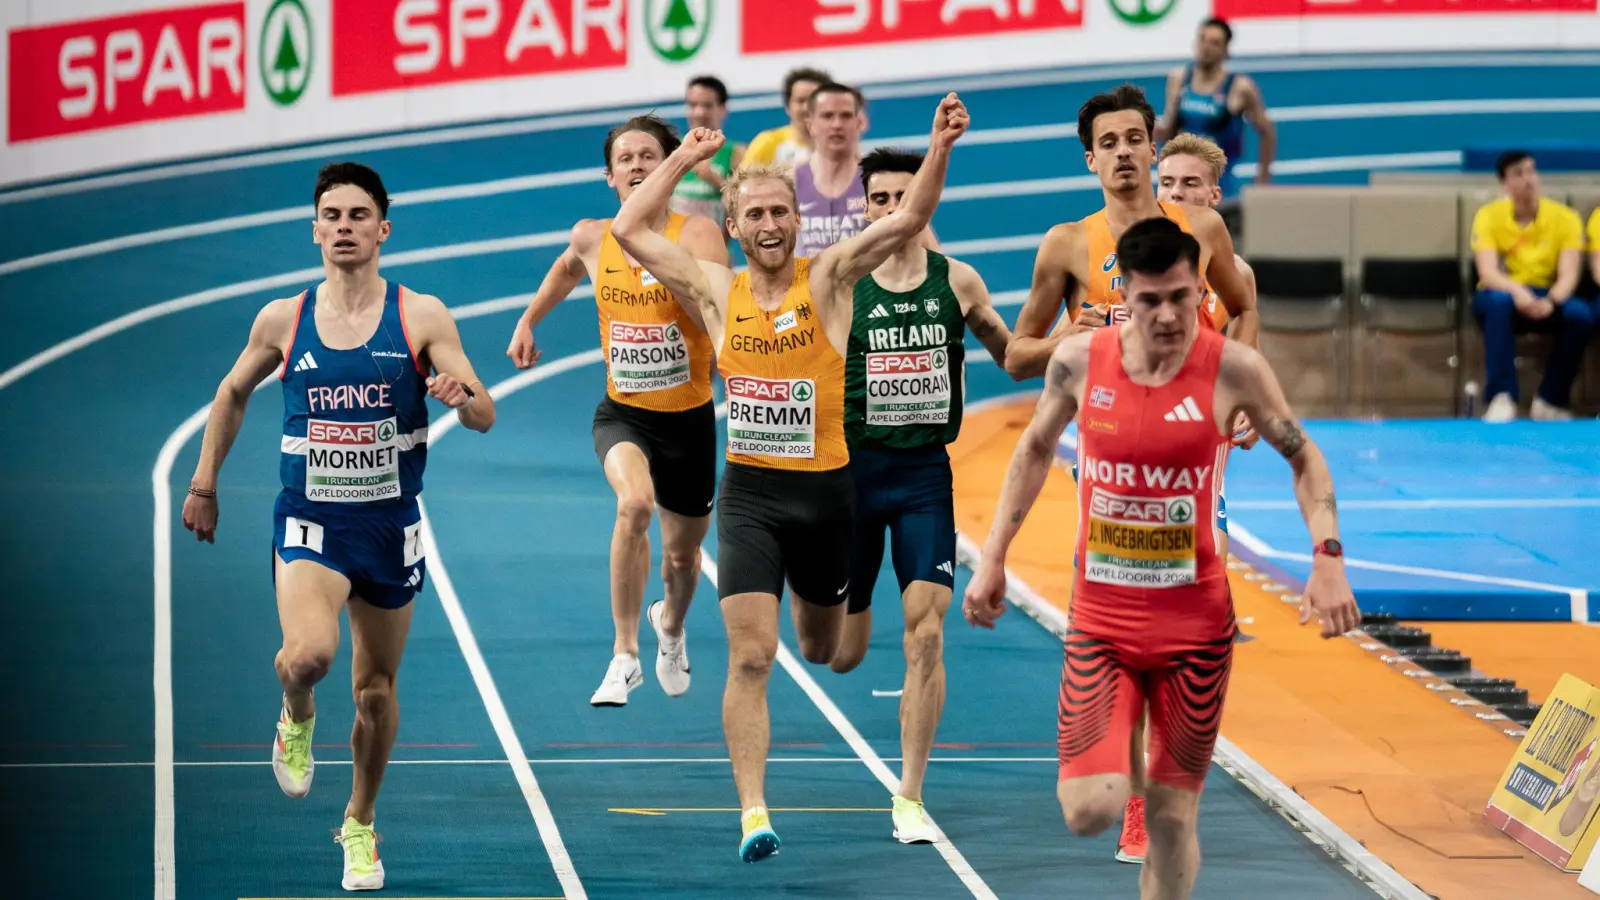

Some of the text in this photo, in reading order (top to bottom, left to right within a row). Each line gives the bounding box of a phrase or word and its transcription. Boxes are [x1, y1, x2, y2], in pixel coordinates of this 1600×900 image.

[394, 0, 626, 74] SPAR
[58, 17, 243, 119] SPAR
[774, 315, 794, 328] WGV
[612, 326, 662, 341] SPAR
[730, 327, 815, 355] GERMANY
[868, 324, 947, 351] IRELAND
[611, 344, 686, 365] PARSONS
[869, 355, 930, 372] SPAR
[668, 373, 688, 385] 2025
[730, 379, 788, 399] SPAR
[869, 374, 948, 397] COSCORAN
[307, 384, 392, 412] FRANCE
[730, 402, 811, 425] BREMM
[870, 413, 929, 422] APELDOORN
[310, 426, 375, 442] SPAR
[744, 431, 762, 439] RUN
[309, 445, 395, 469] MORNET
[788, 445, 811, 453] 2025
[330, 477, 349, 485] RUN
[1085, 456, 1211, 490] NORWAY
[310, 484, 397, 498] APELDOORN 2025
[1092, 493, 1165, 520] SPAR
[299, 524, 308, 545] 1
[1088, 522, 1192, 551] J. INGEBRIGTSEN
[1088, 566, 1160, 583] APELDOORN
[1508, 767, 1554, 805] SWITZERLAND
